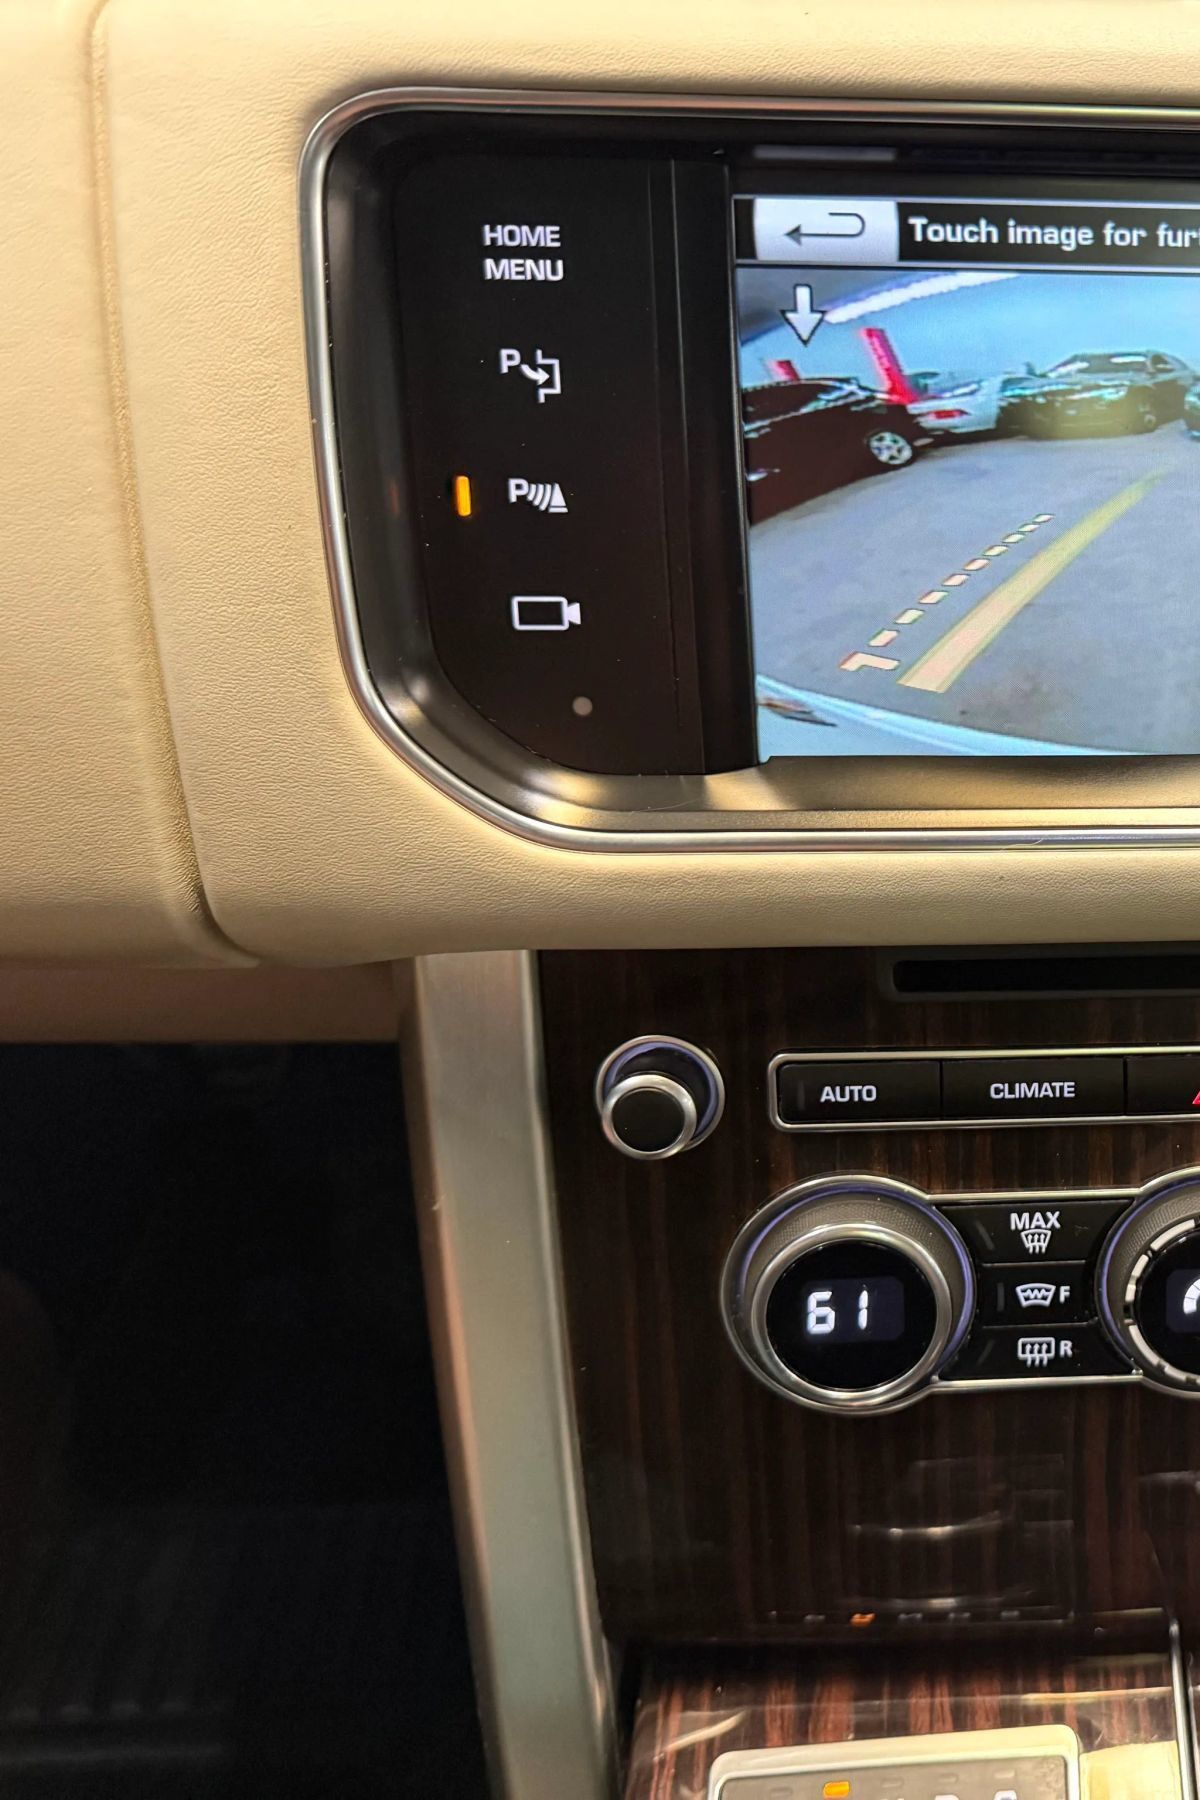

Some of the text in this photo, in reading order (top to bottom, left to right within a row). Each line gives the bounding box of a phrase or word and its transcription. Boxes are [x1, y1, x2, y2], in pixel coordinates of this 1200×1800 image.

[483, 224, 562, 248] HOME
[907, 216, 999, 244] Touch
[1006, 218, 1095, 252] image
[1103, 221, 1148, 247] for
[483, 258, 564, 283] MENU
[819, 1084, 878, 1103] AUTO
[989, 1081, 1076, 1100] CLIMATE
[1009, 1210, 1061, 1231] MAX
[1059, 1285, 1071, 1303] F
[806, 1289, 870, 1336] 61
[1060, 1339, 1073, 1357] R
